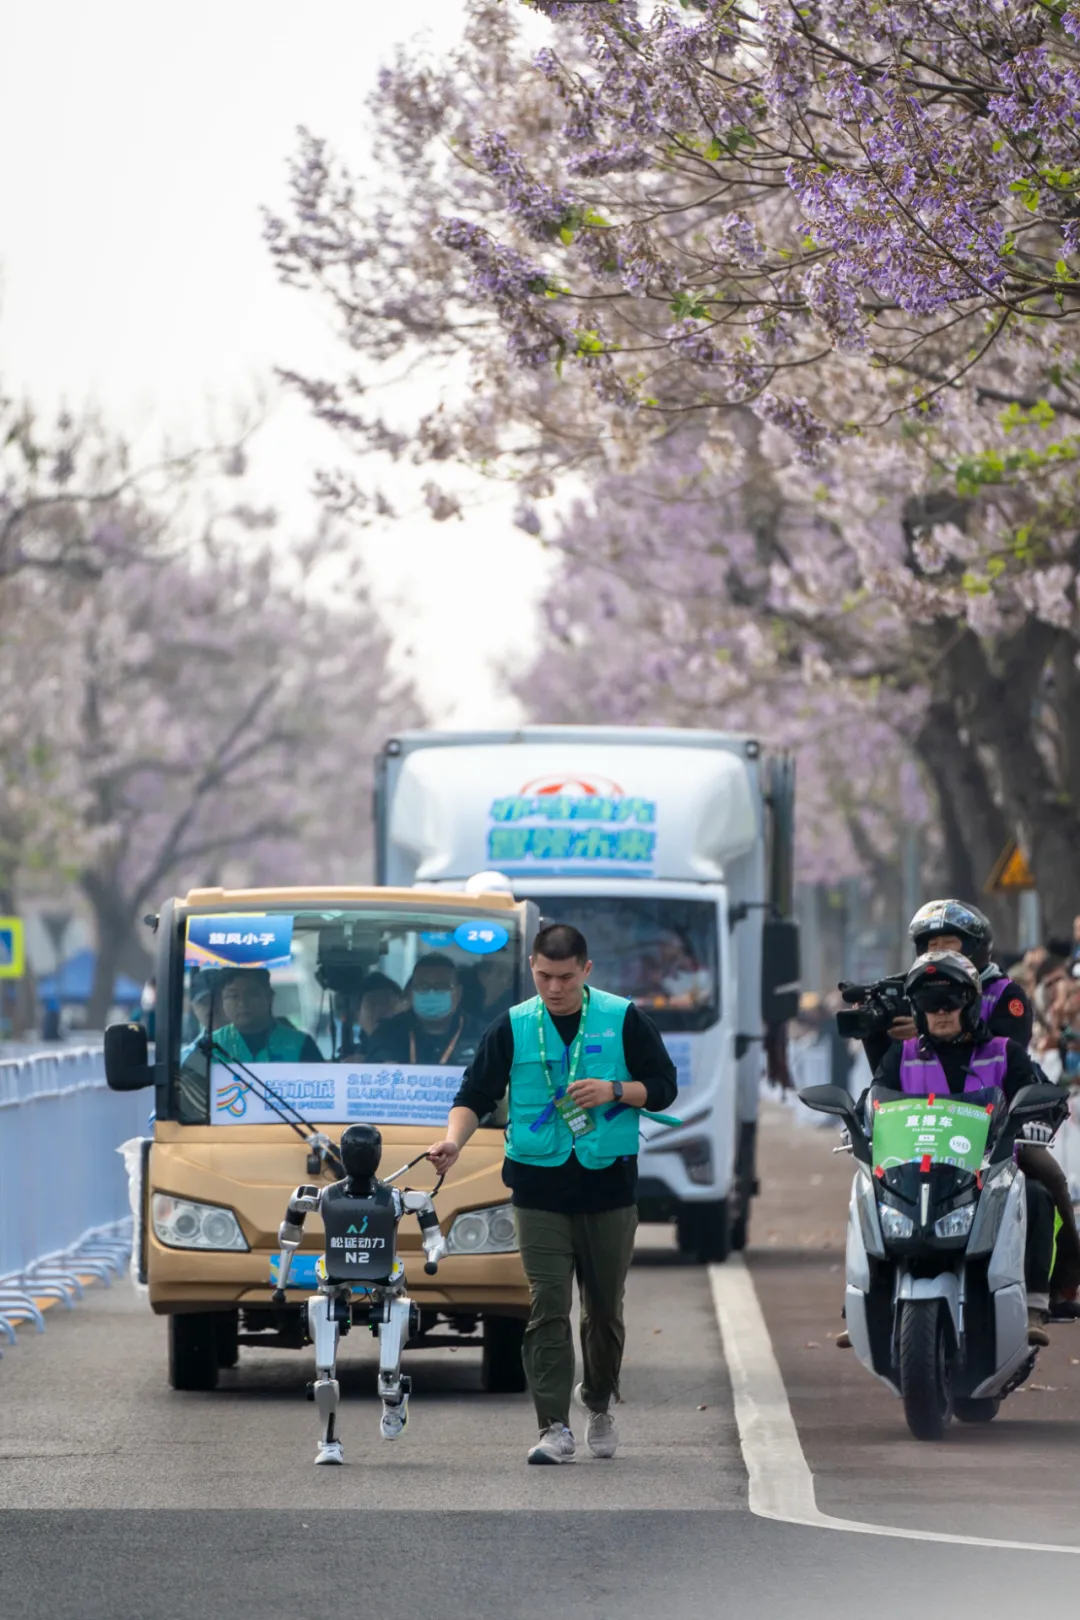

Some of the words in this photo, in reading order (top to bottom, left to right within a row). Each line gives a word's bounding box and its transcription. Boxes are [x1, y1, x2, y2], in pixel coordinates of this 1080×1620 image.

[208, 932, 275, 946] 旋风小子
[467, 929, 495, 943] 2号
[905, 1115, 953, 1128] 直播车
[330, 1236, 385, 1249] 松延动力
[345, 1251, 370, 1264] N2
